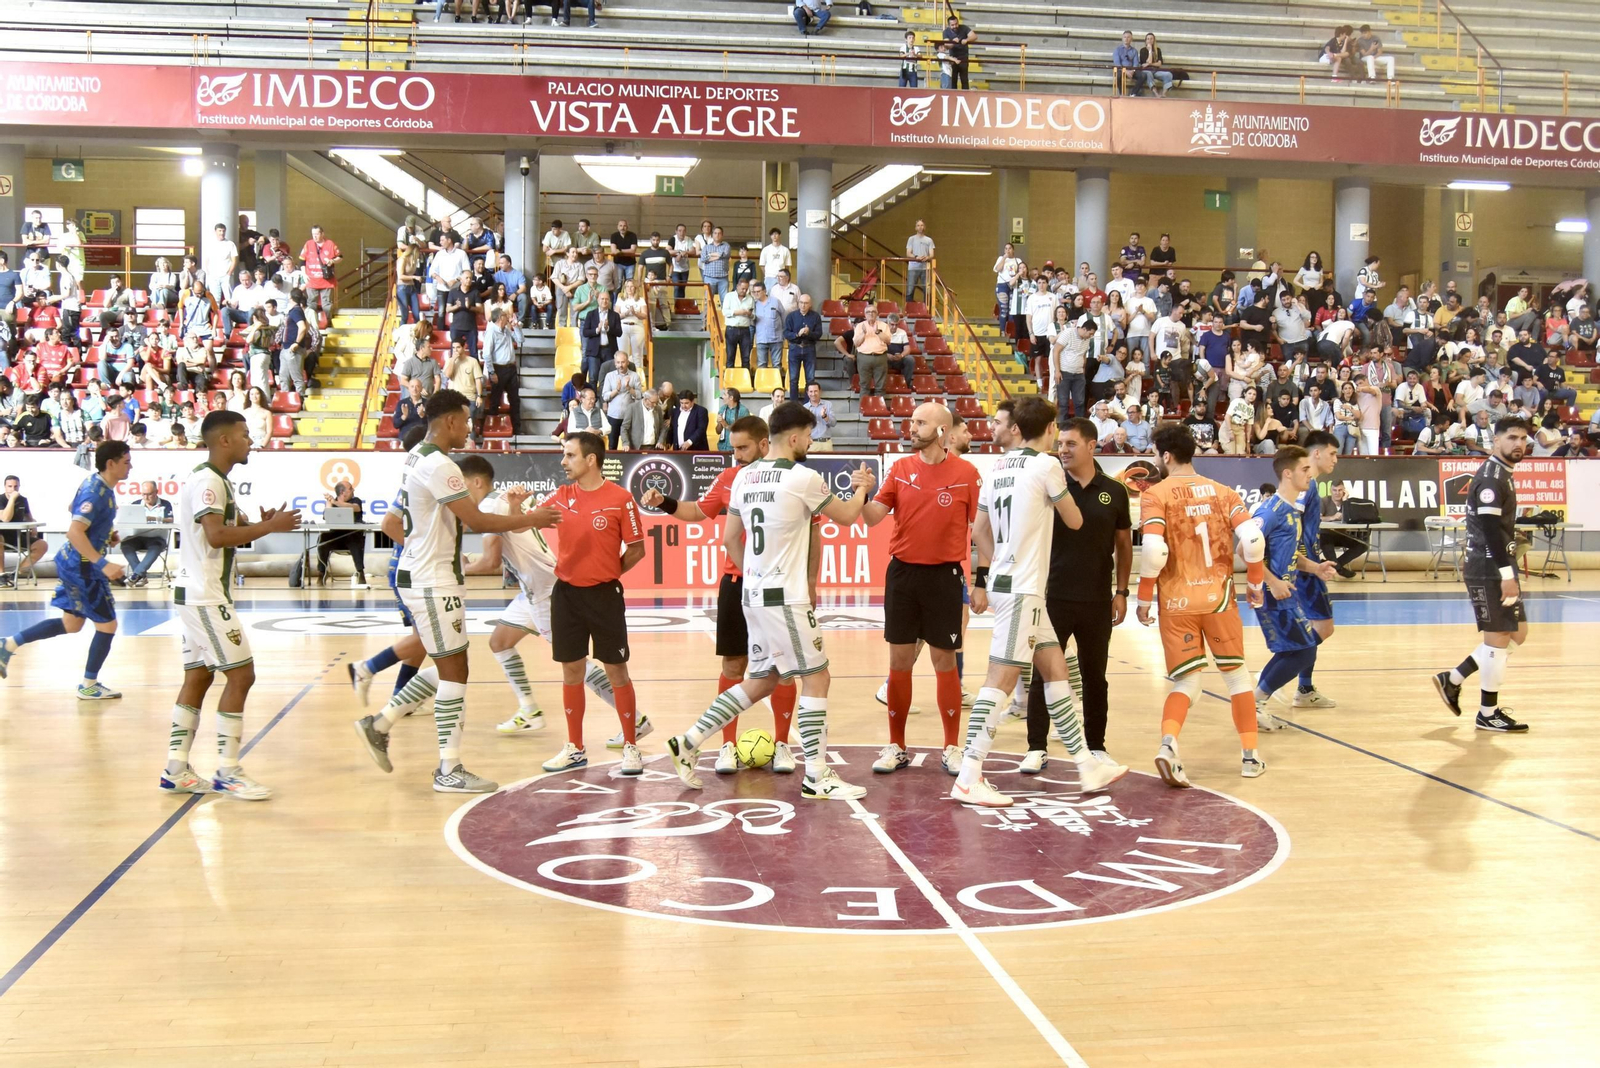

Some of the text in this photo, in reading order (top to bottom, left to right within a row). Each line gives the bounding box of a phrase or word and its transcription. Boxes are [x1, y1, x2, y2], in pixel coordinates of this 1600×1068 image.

[7, 75, 101, 93] AYUNTAMIENTO
[253, 73, 435, 111] IMDECO
[548, 82, 779, 101] PALACIO MUNICIPAL DEPORTES
[7, 94, 88, 112] DE CÓRDOBA
[198, 113, 433, 130] Instituto Municipal de Deportes Córdoba
[530, 100, 801, 138] VISTA ALEGRE
[941, 95, 1105, 132] IMDECO
[1232, 115, 1309, 131] AYUNTAMIENTO
[890, 132, 1103, 149] Instituto Municipal de Deportes Córdoba
[1232, 131, 1298, 148] DE CÓRDOBA
[1419, 153, 1459, 163] Instituto
[1461, 154, 1508, 167] Municipal
[1510, 156, 1522, 166] de
[1525, 157, 1568, 168] Deportes
[61, 162, 76, 178] G
[663, 178, 675, 192] H
[638, 463, 673, 476] MAR DE
[1534, 462, 1554, 472] RUTA
[1556, 462, 1563, 472] 4
[1550, 480, 1564, 489] 483
[1343, 480, 1437, 509] MILAR
[1536, 492, 1564, 502] SEVILLA
[994, 494, 1012, 544] 11
[751, 507, 765, 556] 6
[1194, 521, 1213, 568] 1
[820, 544, 871, 584] ALA
[218, 605, 231, 621] 8
[807, 610, 817, 629] 6
[1032, 607, 1041, 627] 11
